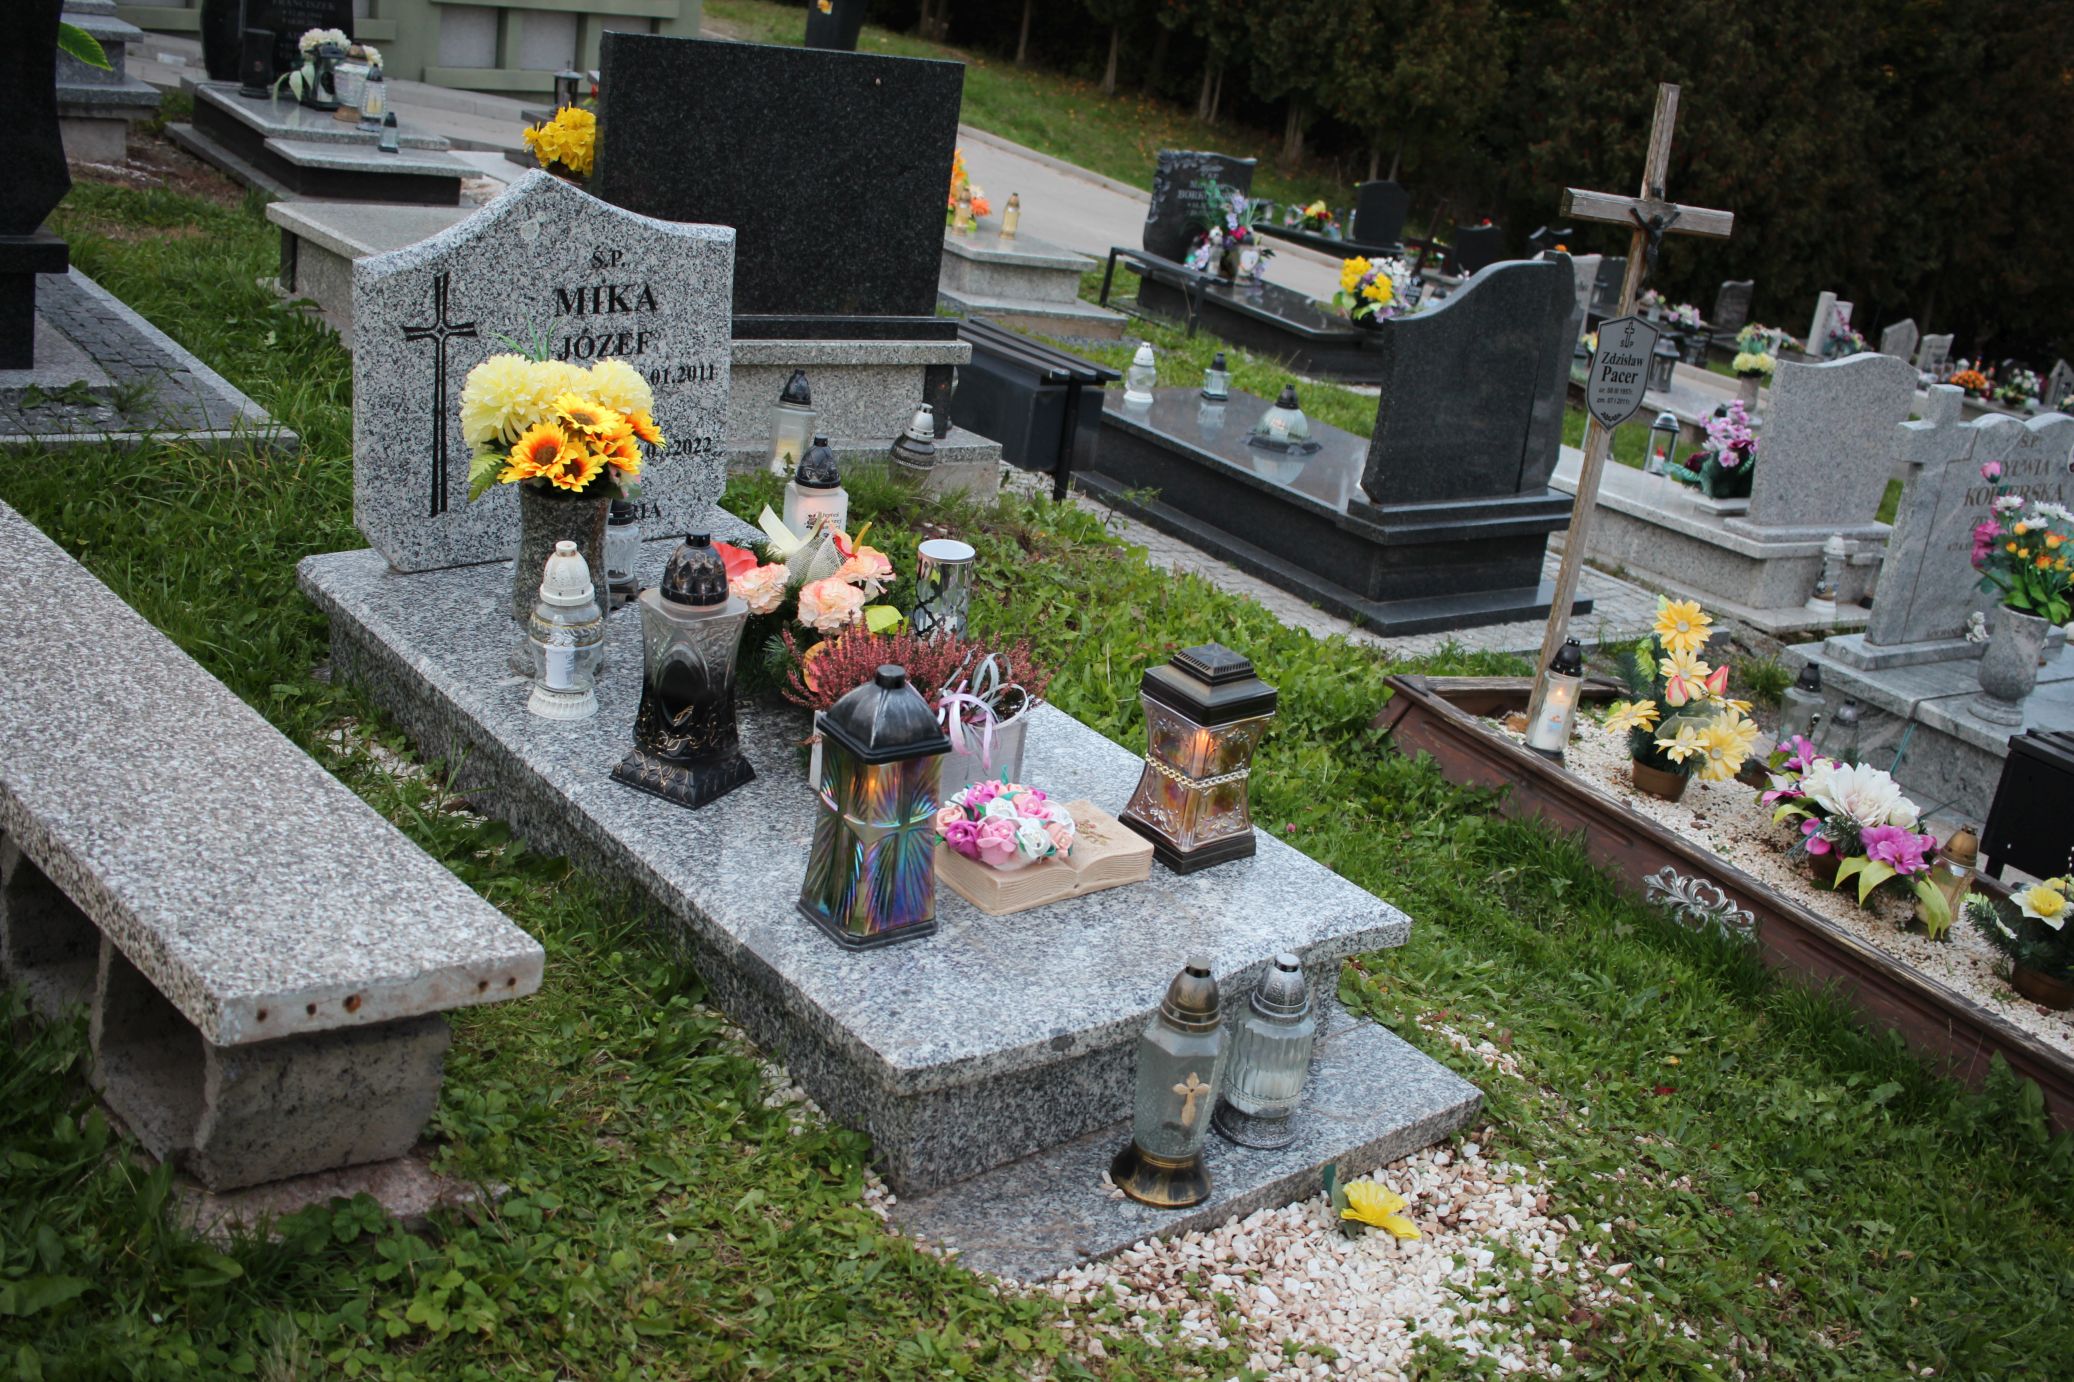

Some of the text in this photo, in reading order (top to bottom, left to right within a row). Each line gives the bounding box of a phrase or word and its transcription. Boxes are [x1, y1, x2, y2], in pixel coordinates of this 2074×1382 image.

[555, 283, 657, 316] MIKA
[558, 328, 652, 361] JÓZEF
[1601, 351, 1643, 366] Zdzisław
[1601, 366, 1638, 384] Pacer
[2002, 459, 2050, 477] YLWIA
